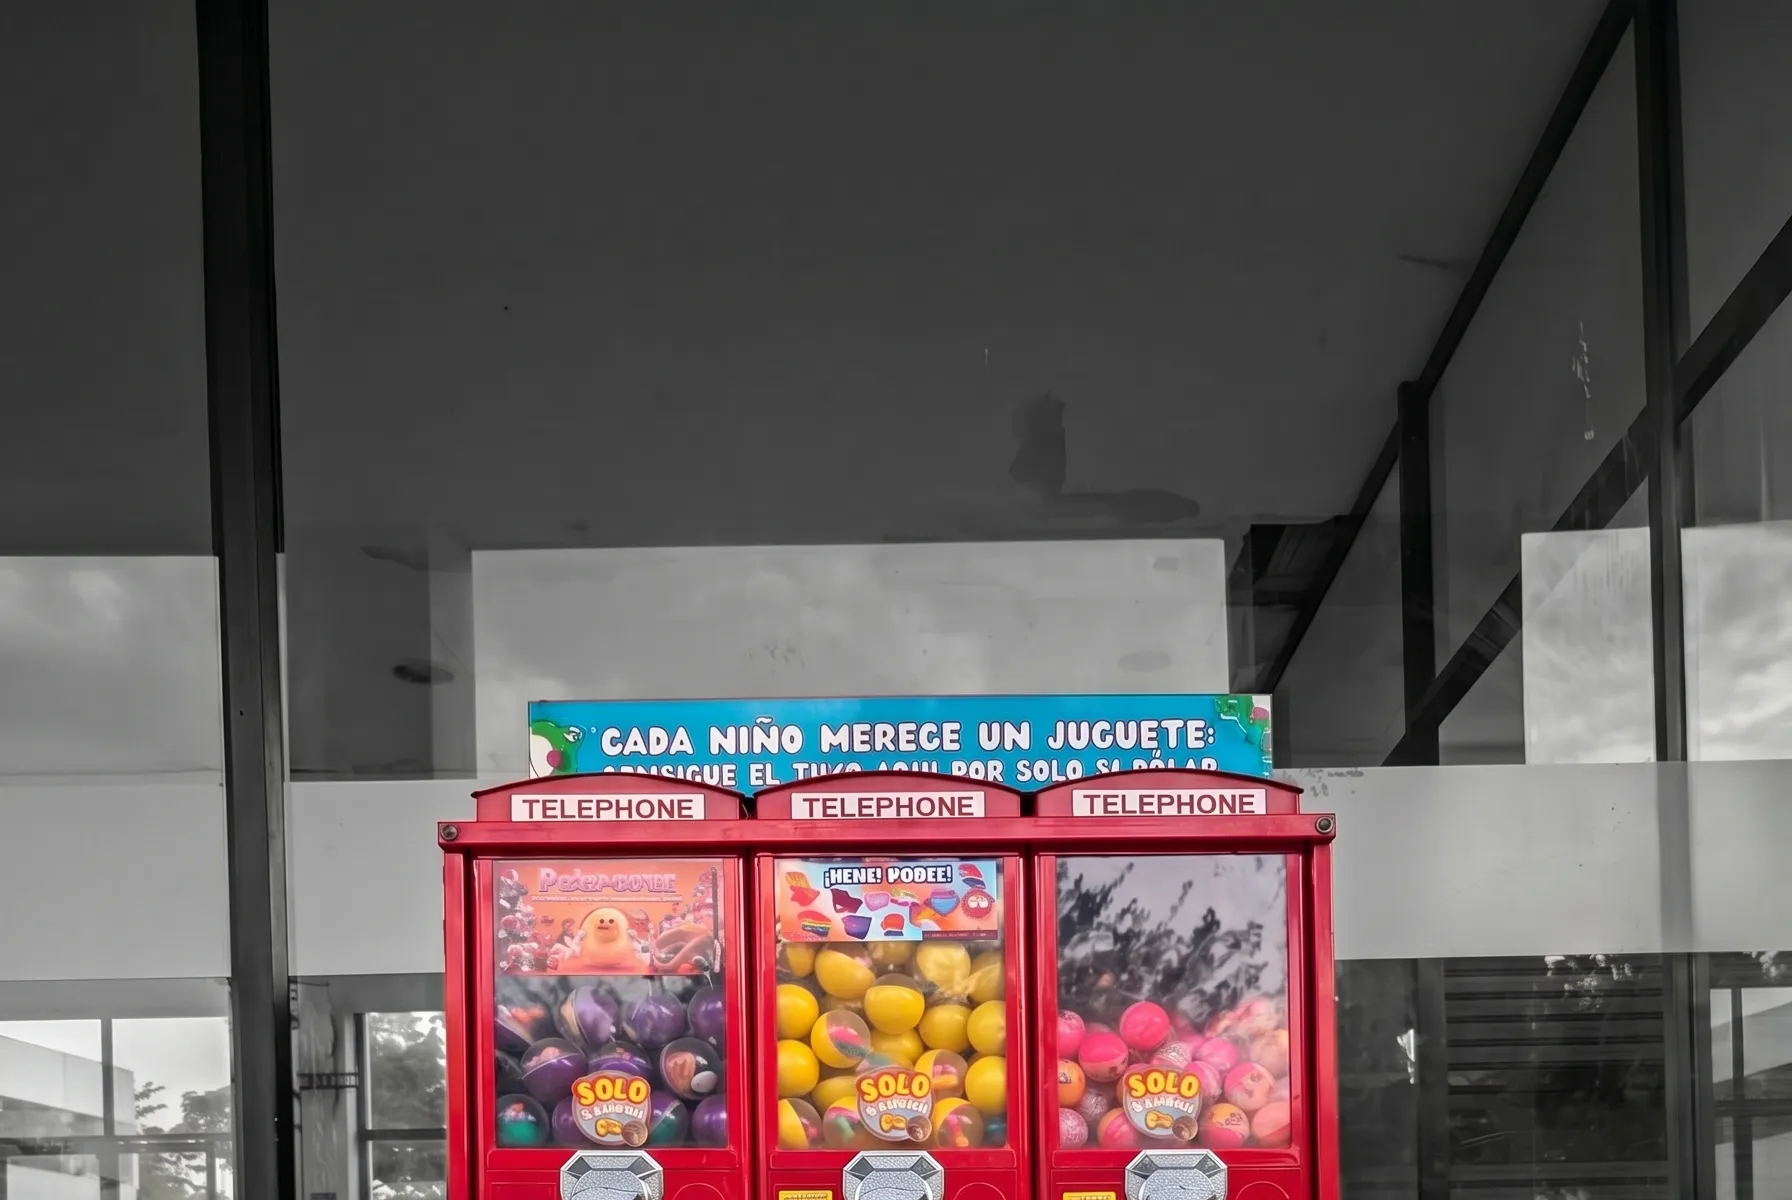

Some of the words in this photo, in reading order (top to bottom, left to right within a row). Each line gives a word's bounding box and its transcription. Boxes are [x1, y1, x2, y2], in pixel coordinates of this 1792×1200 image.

[601, 726, 695, 756] CADA
[708, 716, 804, 755] NIÑO
[820, 721, 962, 753] MERECE
[977, 721, 1031, 751] UN
[1047, 719, 1216, 750] JUGUETE:
[749, 761, 781, 786] EL
[951, 759, 1004, 782] POR
[1016, 758, 1083, 782] SOLO
[522, 798, 694, 820] TELEPHONE
[802, 796, 974, 818] TELEPHONE
[1083, 793, 1255, 815] TELEPHONE
[576, 1075, 648, 1106] SOLO
[859, 1072, 931, 1103] SOLO
[1127, 1069, 1200, 1098] SOLO
